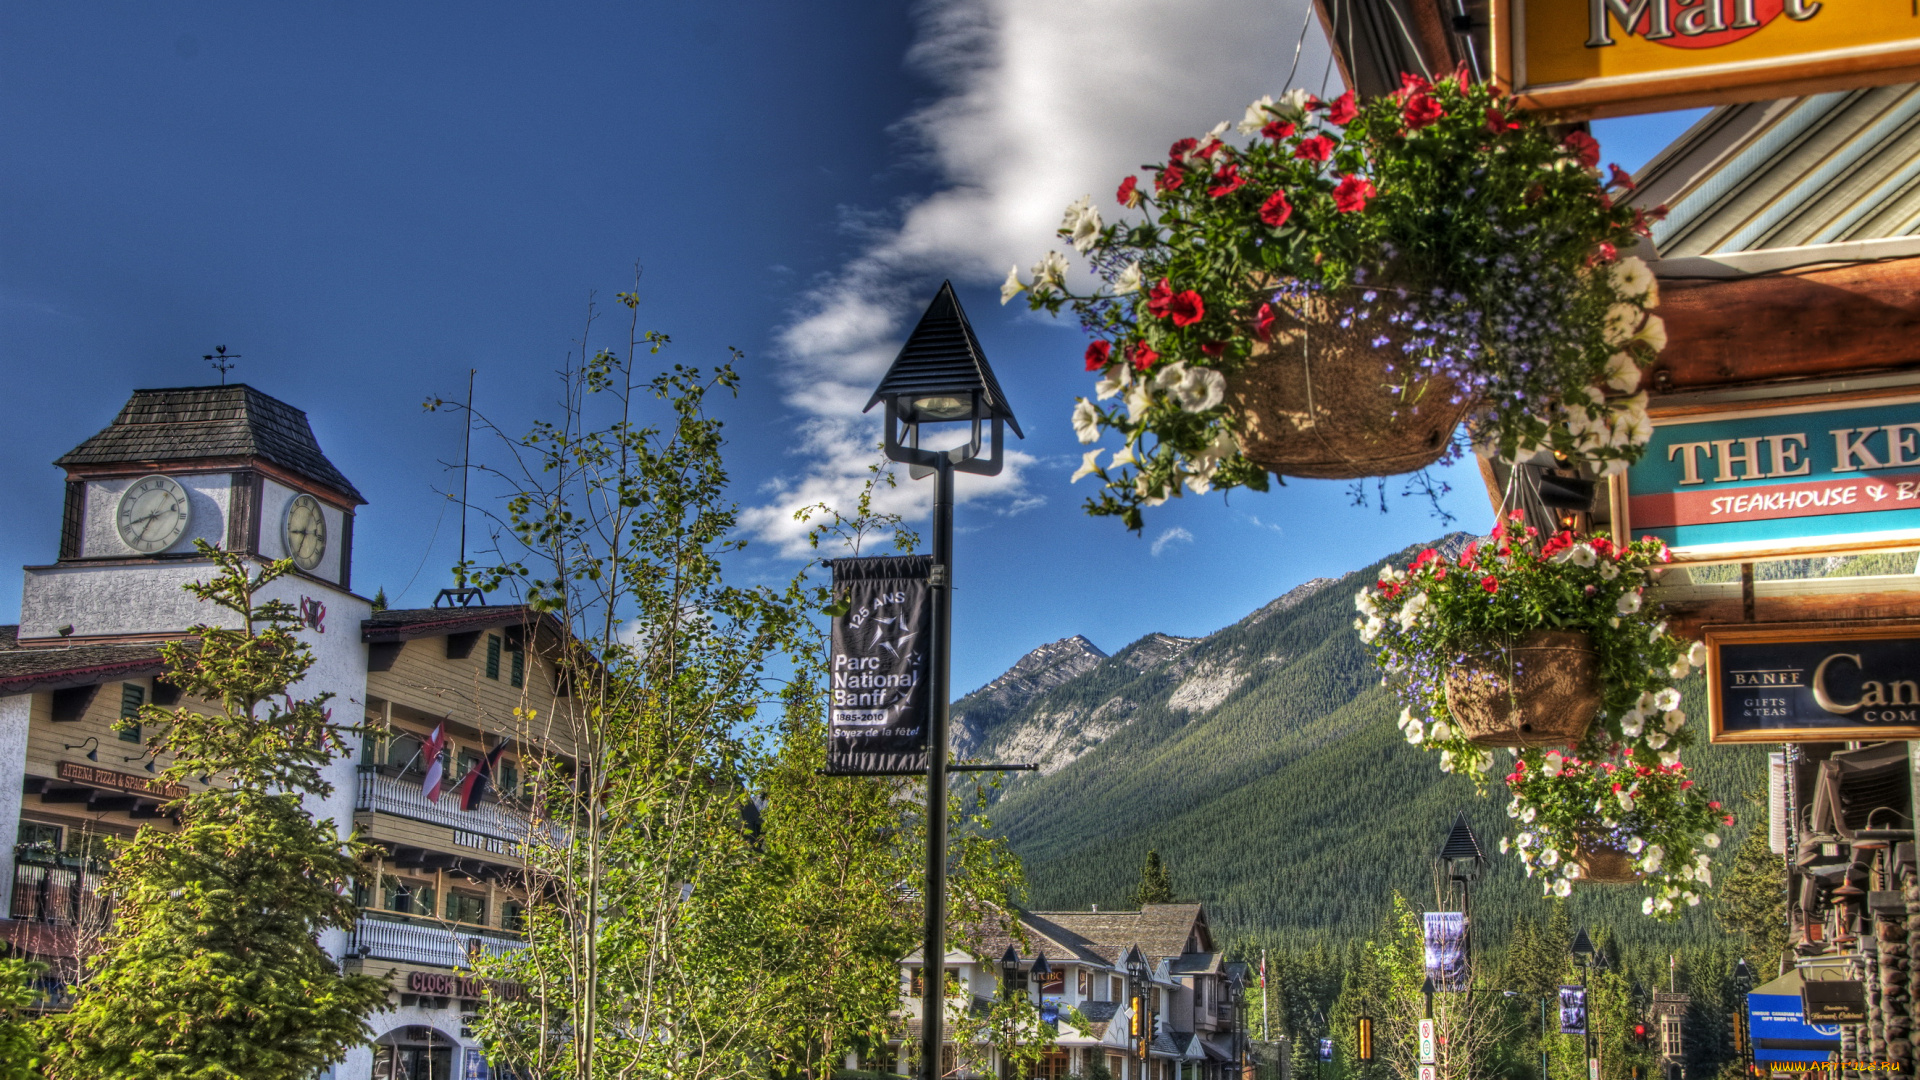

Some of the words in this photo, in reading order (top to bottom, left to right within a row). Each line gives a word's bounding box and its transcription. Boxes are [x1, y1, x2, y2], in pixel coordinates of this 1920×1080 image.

[1667, 432, 1811, 486] THE
[1709, 485, 1858, 516] STEAKHOUSE
[1866, 484, 1889, 501] &
[849, 606, 870, 629] 125
[873, 591, 906, 611] ANS
[835, 653, 880, 671] Parc
[834, 669, 918, 689] National
[1735, 672, 1800, 685] BANFF
[1812, 653, 1920, 715] Can
[834, 688, 887, 706] Banff
[1744, 698, 1786, 707] GIFTS
[836, 713, 884, 722] 1885-2010
[1743, 708, 1751, 717] &
[1754, 707, 1787, 717] TEAS
[1863, 710, 1917, 722] COM
[833, 727, 863, 739] Soyez
[865, 727, 879, 737] de
[882, 727, 892, 736] la
[895, 726, 920, 736] fête!
[62, 763, 93, 781] ATHENA
[95, 769, 117, 786] PIZZA
[118, 774, 124, 787] &
[454, 830, 484, 850] BANFF
[486, 837, 506, 855] AVE.
[411, 970, 454, 995] CLOCK
